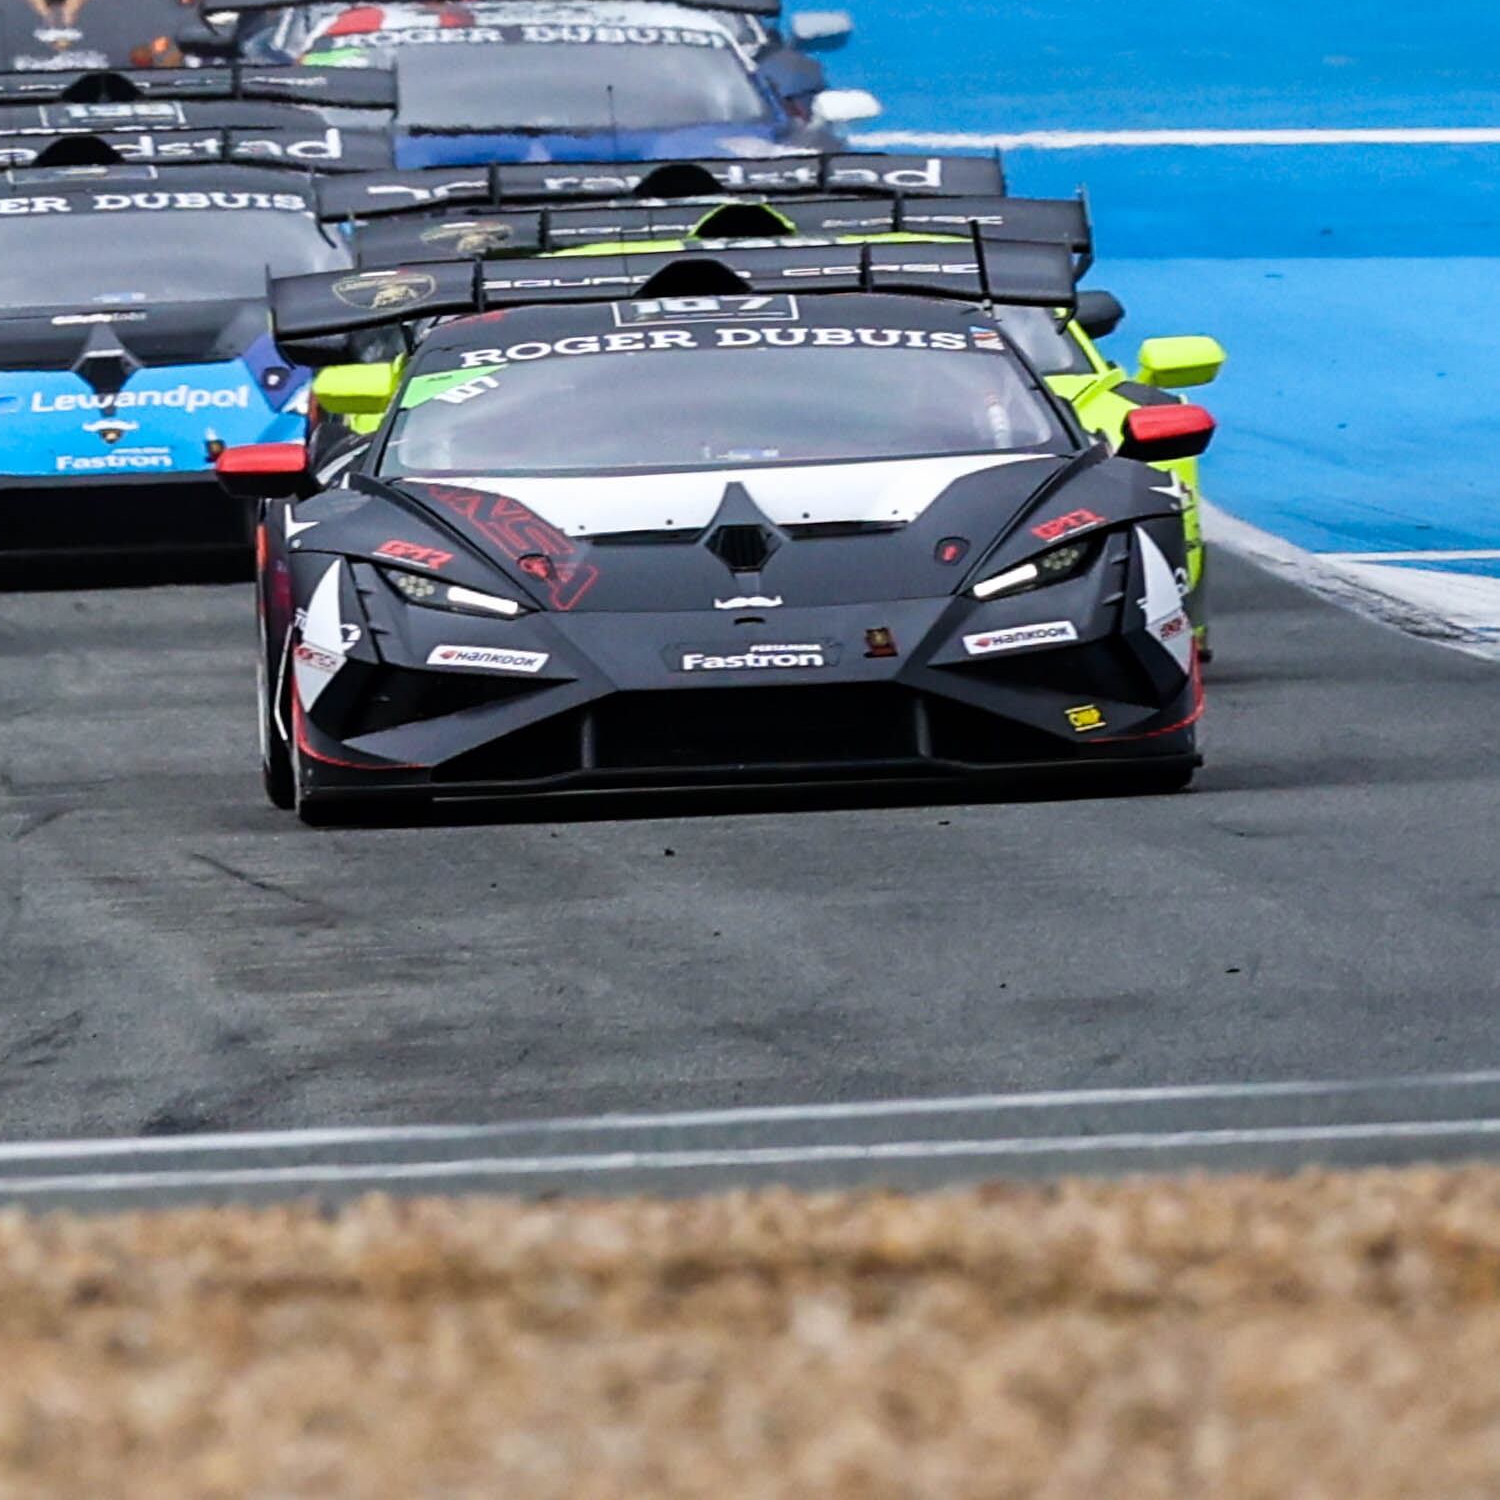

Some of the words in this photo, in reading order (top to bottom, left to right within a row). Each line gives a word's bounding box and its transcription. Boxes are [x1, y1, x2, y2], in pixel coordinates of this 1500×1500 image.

[92, 192, 309, 212] DUBUIS
[460, 329, 699, 368] ROGER
[715, 325, 968, 350] DUBUIS
[30, 384, 251, 414] Lewandpol
[56, 453, 172, 472] Fastron
[682, 651, 824, 671] Fastron
